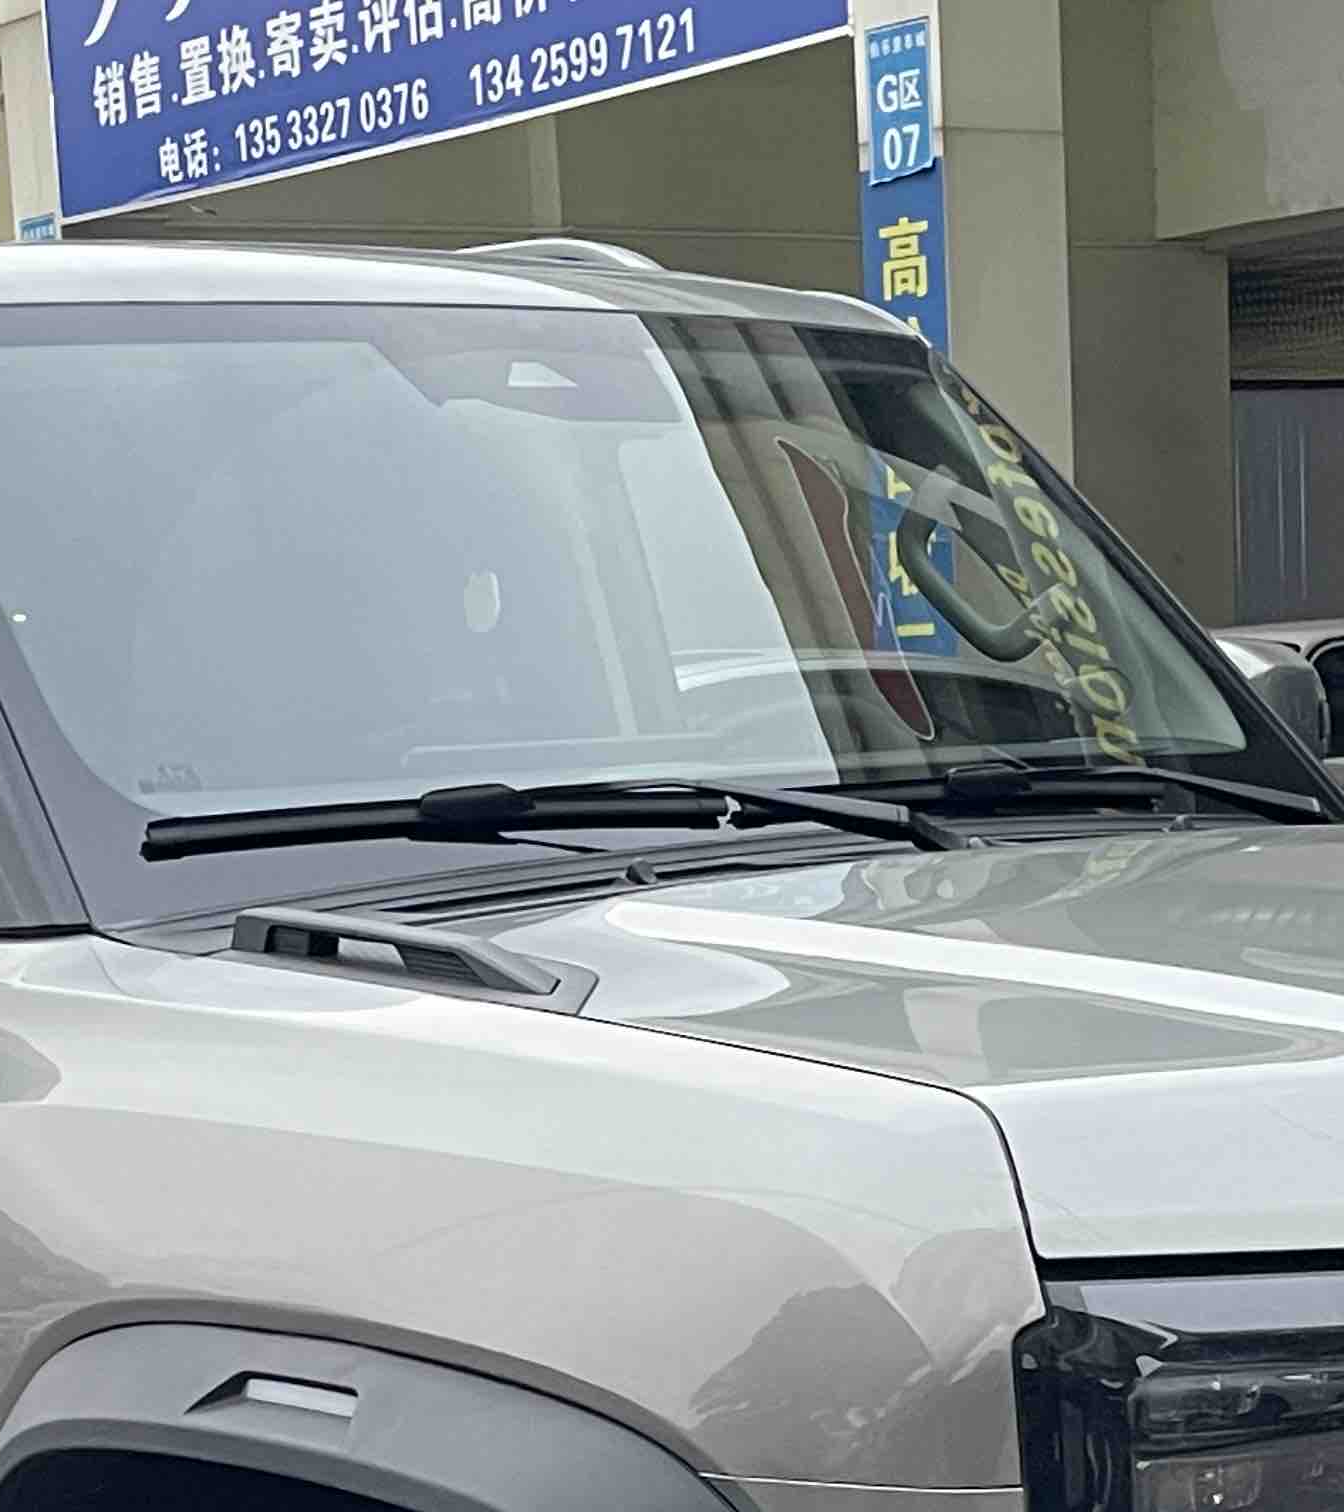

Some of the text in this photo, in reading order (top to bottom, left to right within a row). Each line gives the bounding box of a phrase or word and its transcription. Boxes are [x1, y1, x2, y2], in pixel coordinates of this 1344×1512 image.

[235, 115, 281, 162] 135
[288, 98, 350, 152] 3327
[359, 78, 430, 133] 0376
[469, 54, 524, 107] 134
[531, 28, 608, 93] 2599
[616, 7, 695, 71] 7121
[876, 68, 923, 113] G区
[882, 123, 921, 171] 07
[878, 216, 929, 336] 高
